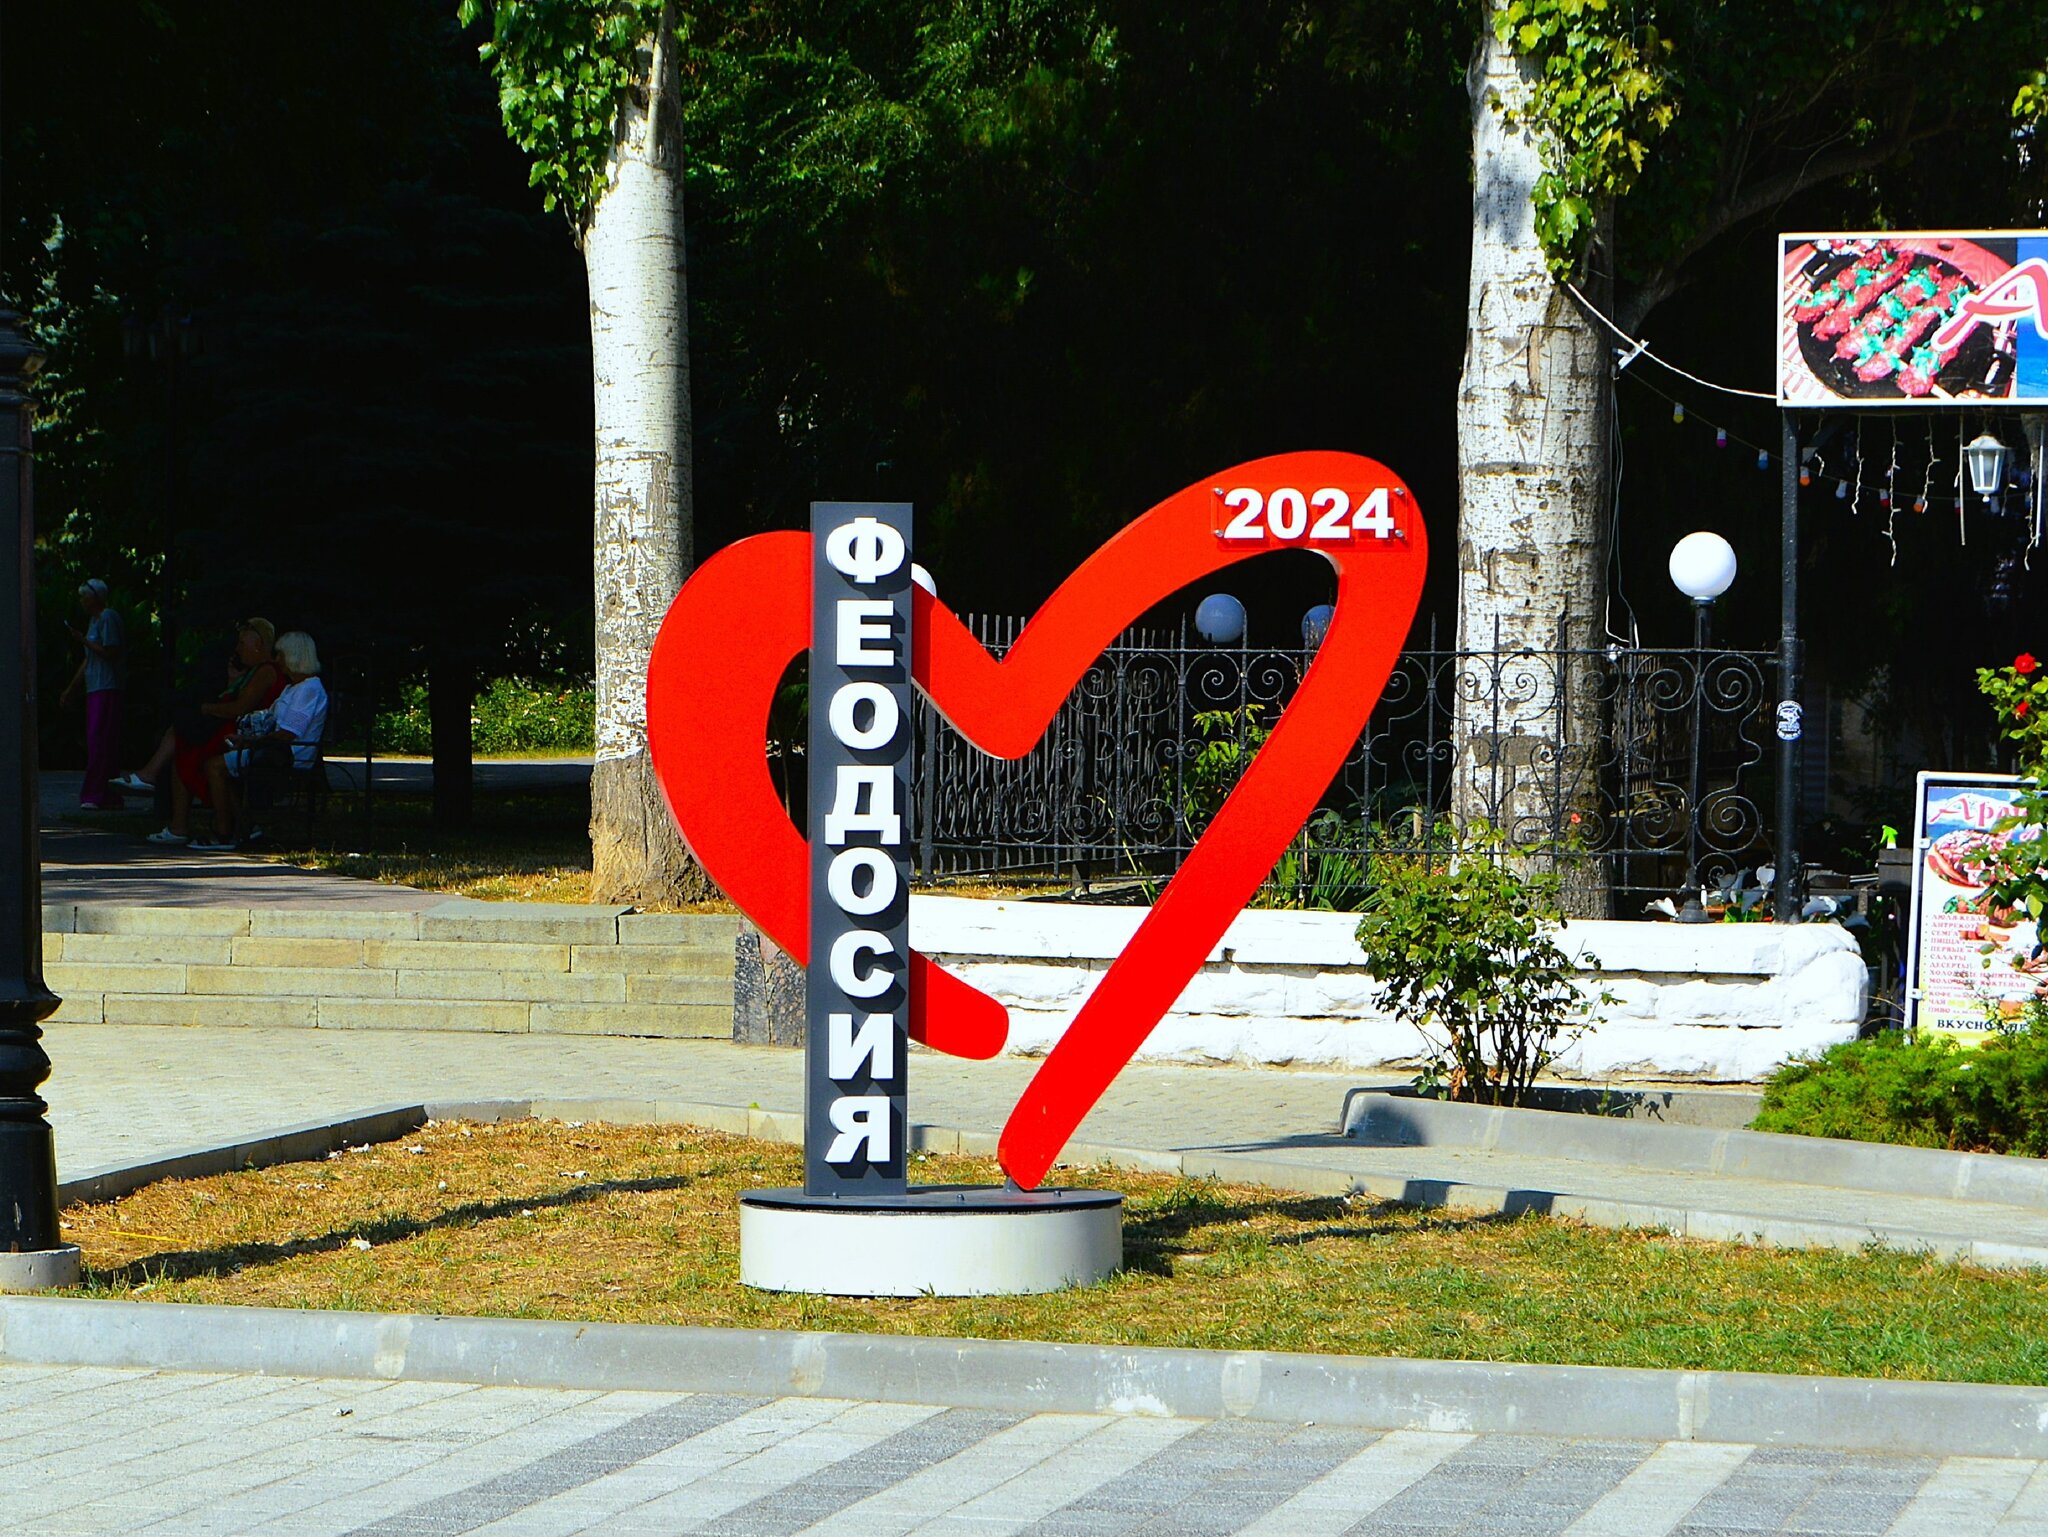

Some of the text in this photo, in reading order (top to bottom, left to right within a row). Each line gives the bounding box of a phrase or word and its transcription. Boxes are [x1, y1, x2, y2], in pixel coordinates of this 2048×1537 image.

[1224, 487, 1395, 540] 2024
[824, 517, 907, 1165] ФЕОДОСИЯ
[1937, 1019, 1993, 1031] ВКУСНО
